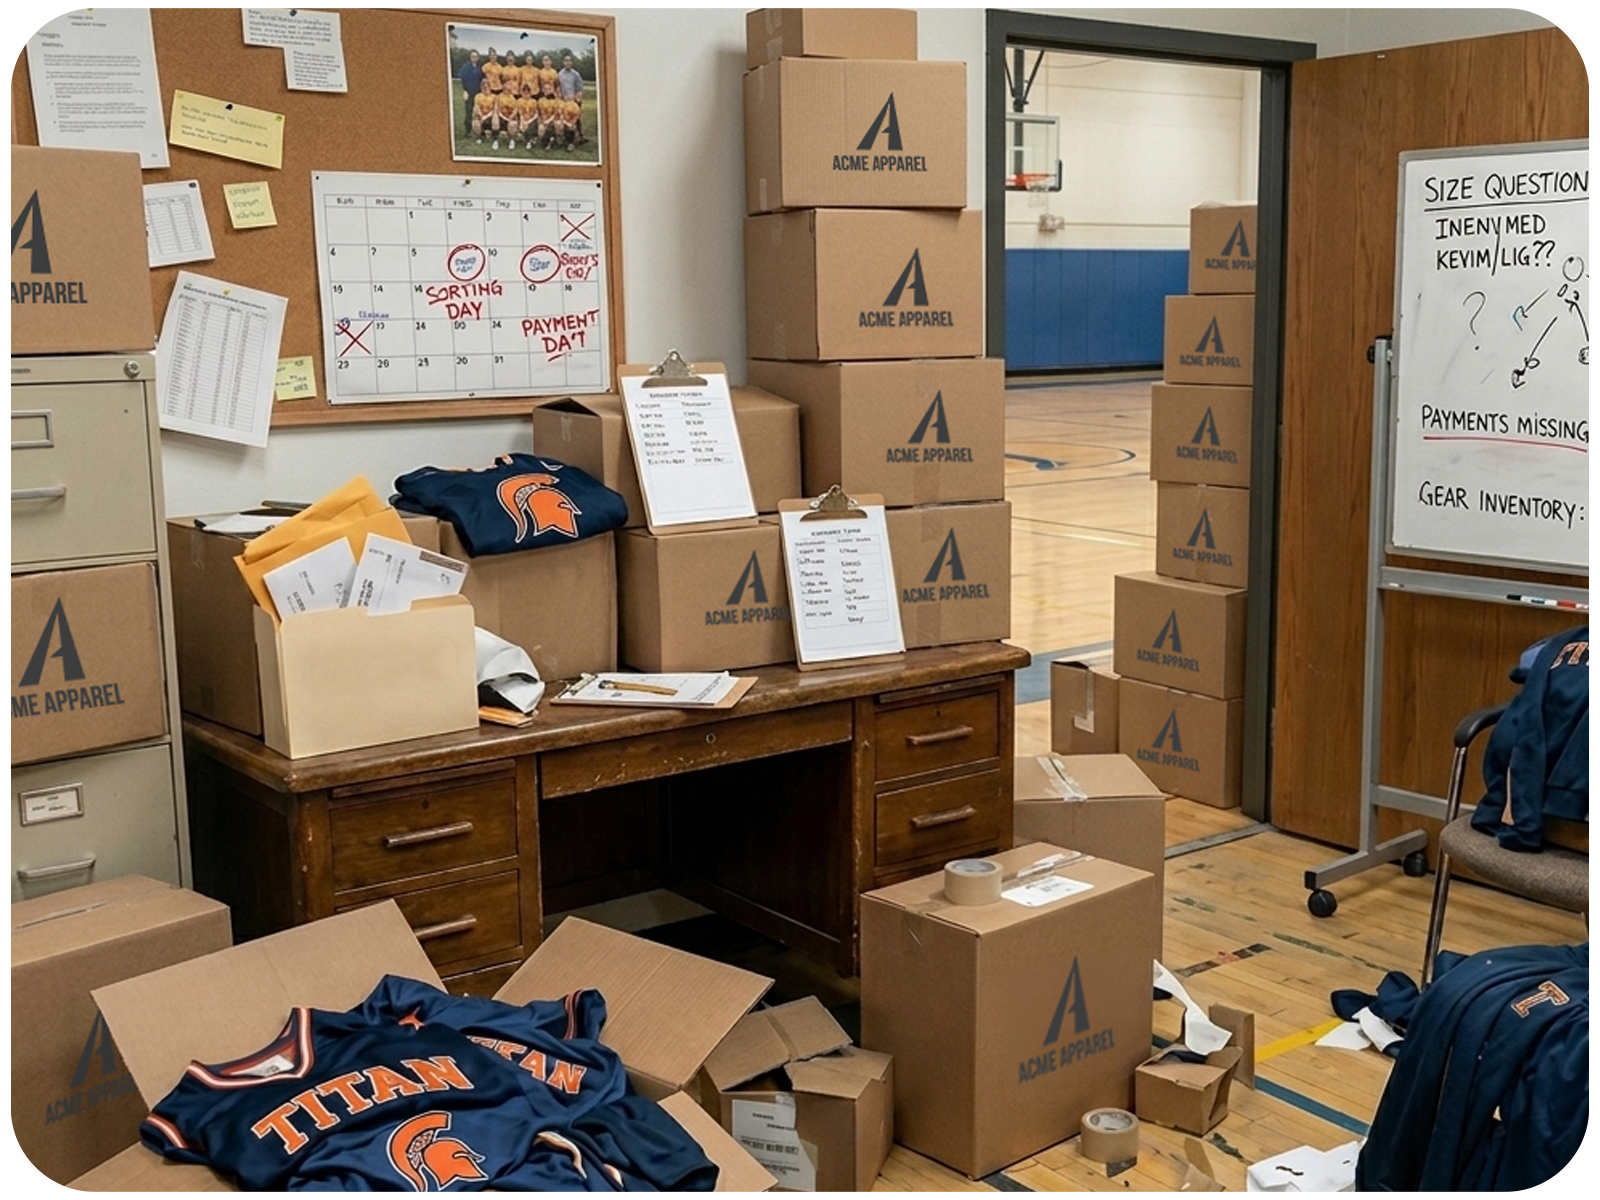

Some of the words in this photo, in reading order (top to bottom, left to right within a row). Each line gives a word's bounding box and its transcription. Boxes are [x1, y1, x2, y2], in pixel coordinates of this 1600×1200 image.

[833, 155, 870, 171] ACME
[872, 155, 927, 172] APPAREL
[1425, 176, 1475, 203] SIZE
[1484, 170, 1589, 200] QUESTION
[426, 279, 503, 305] SORTING
[446, 301, 482, 320] DAY
[521, 309, 600, 337] PAYMENT
[859, 311, 896, 327] ACME
[899, 311, 954, 327] APPAREL
[1422, 404, 1509, 433] PAYMENTS
[886, 447, 920, 463] ACME
[923, 447, 973, 463] APPAREL
[1419, 481, 1469, 509] GEAR
[1480, 490, 1585, 529] INVENTORY:
[902, 587, 937, 603] ACME
[939, 583, 990, 601] APPAREL
[705, 609, 739, 626] ACME
[10, 693, 41, 718] ME
[45, 682, 125, 714] APPAREL
[1511, 980, 1570, 1018] T
[1018, 1049, 1057, 1084] ACME
[1060, 1027, 1115, 1068] APPAREL
[45, 1092, 85, 1126] ACME
[251, 1056, 474, 1155] TITAN
